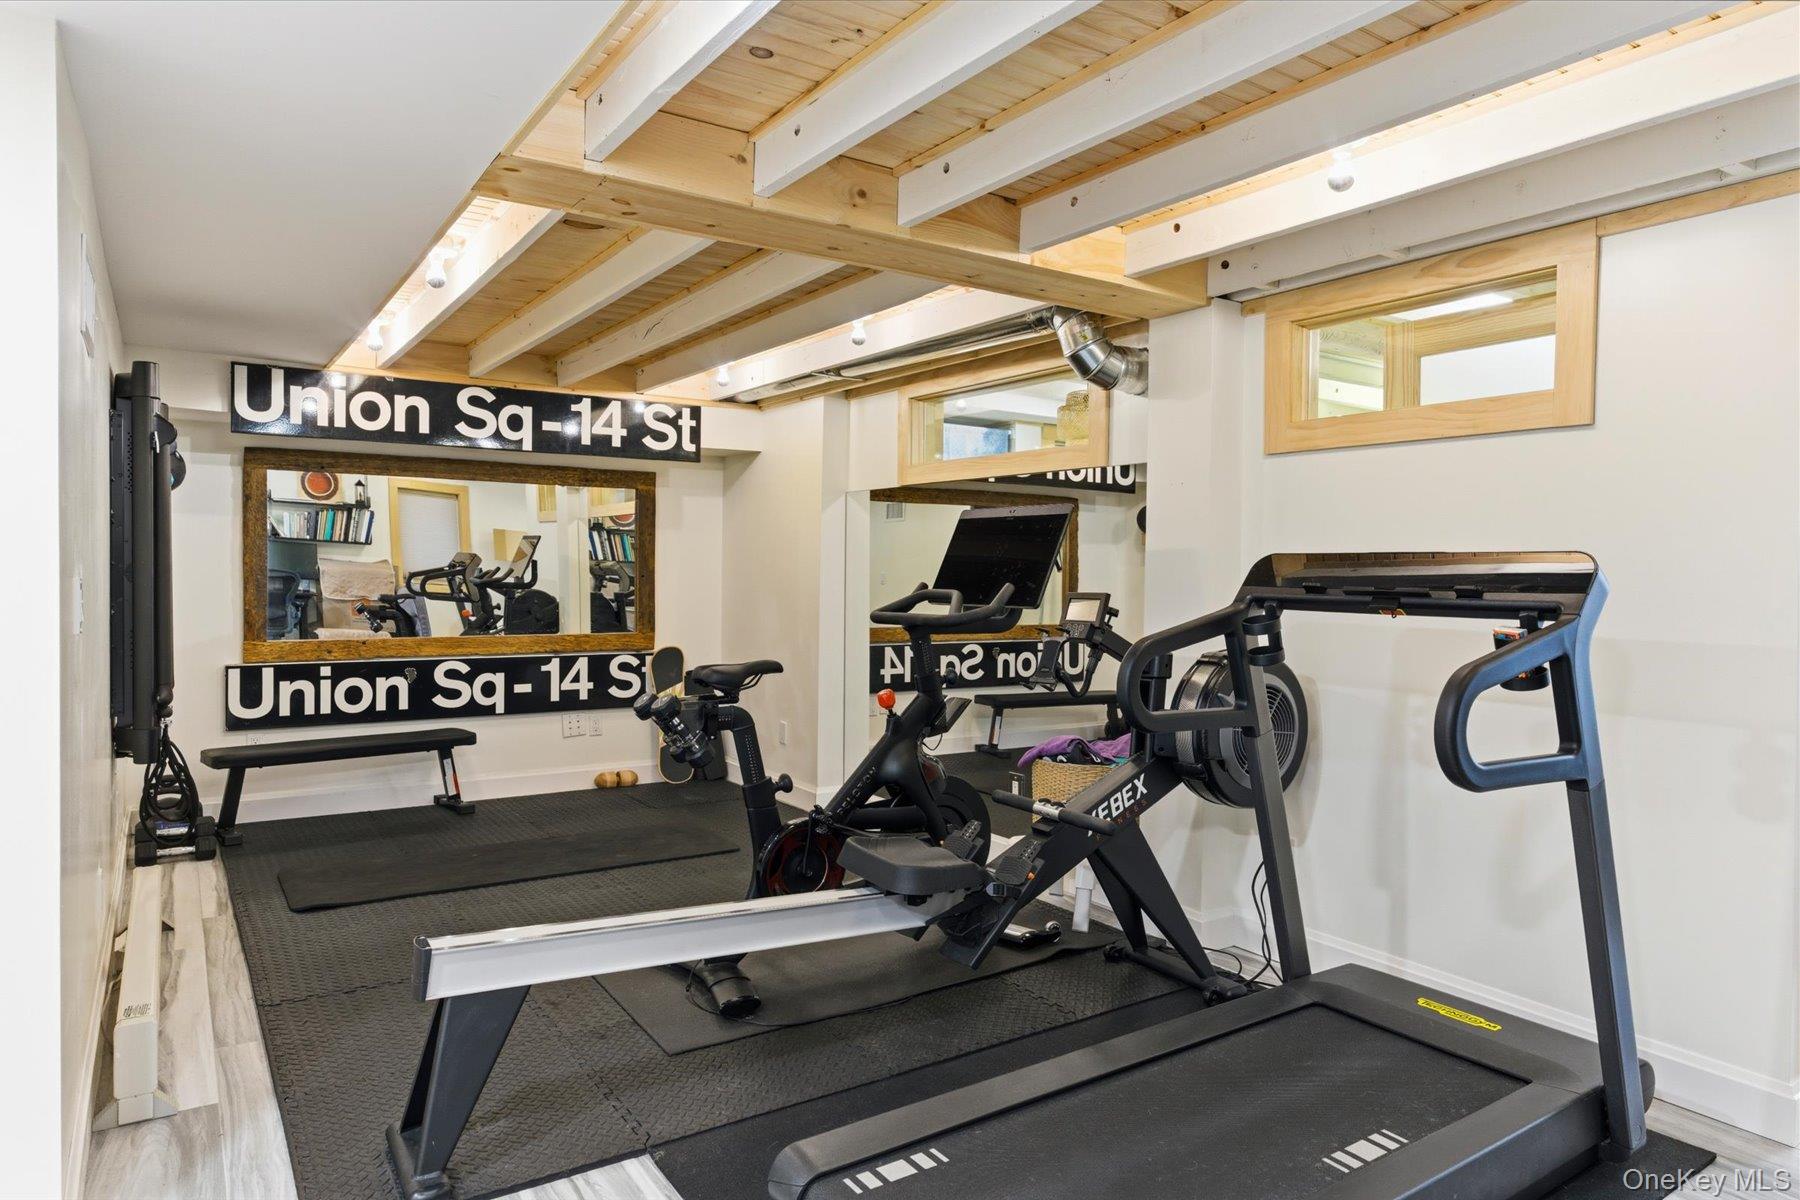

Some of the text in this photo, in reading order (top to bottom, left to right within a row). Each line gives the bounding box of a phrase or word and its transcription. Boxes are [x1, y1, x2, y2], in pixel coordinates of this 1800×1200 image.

[234, 364, 430, 434] Union
[641, 403, 698, 453] St
[227, 665, 409, 719] Union
[1087, 772, 1148, 838] EBEX
